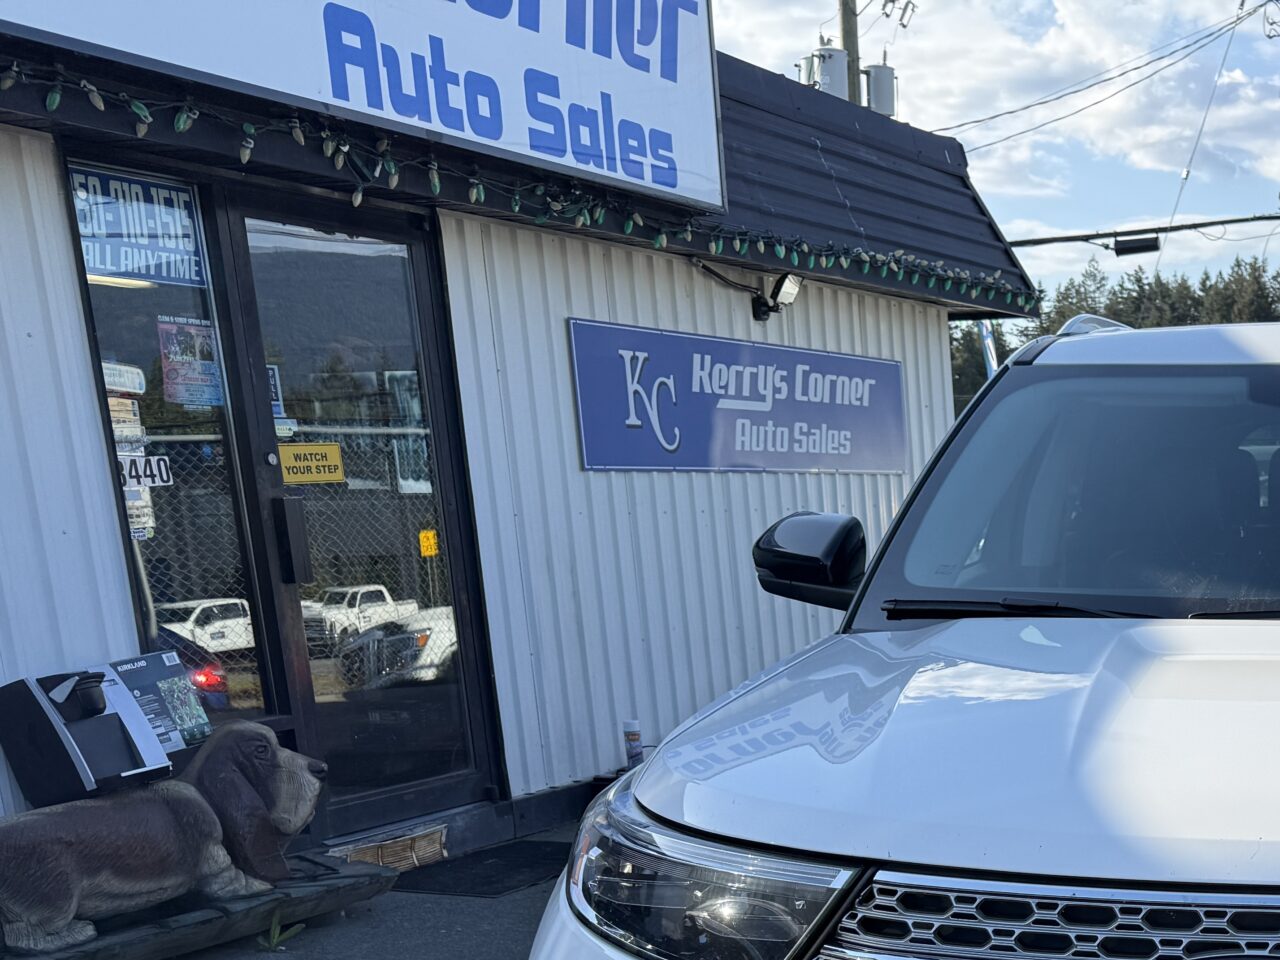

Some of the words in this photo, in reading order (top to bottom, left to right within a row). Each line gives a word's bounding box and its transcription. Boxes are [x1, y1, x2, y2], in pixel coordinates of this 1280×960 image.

[322, 1, 504, 141] Auto
[523, 68, 679, 189] Sales
[120, 246, 201, 281] ANYTIME
[795, 364, 876, 407] Corner
[735, 418, 789, 453] Auto
[793, 422, 852, 455] Sales
[285, 465, 313, 475] YOUR
[315, 464, 340, 475] STEP
[292, 452, 328, 463] WATCH
